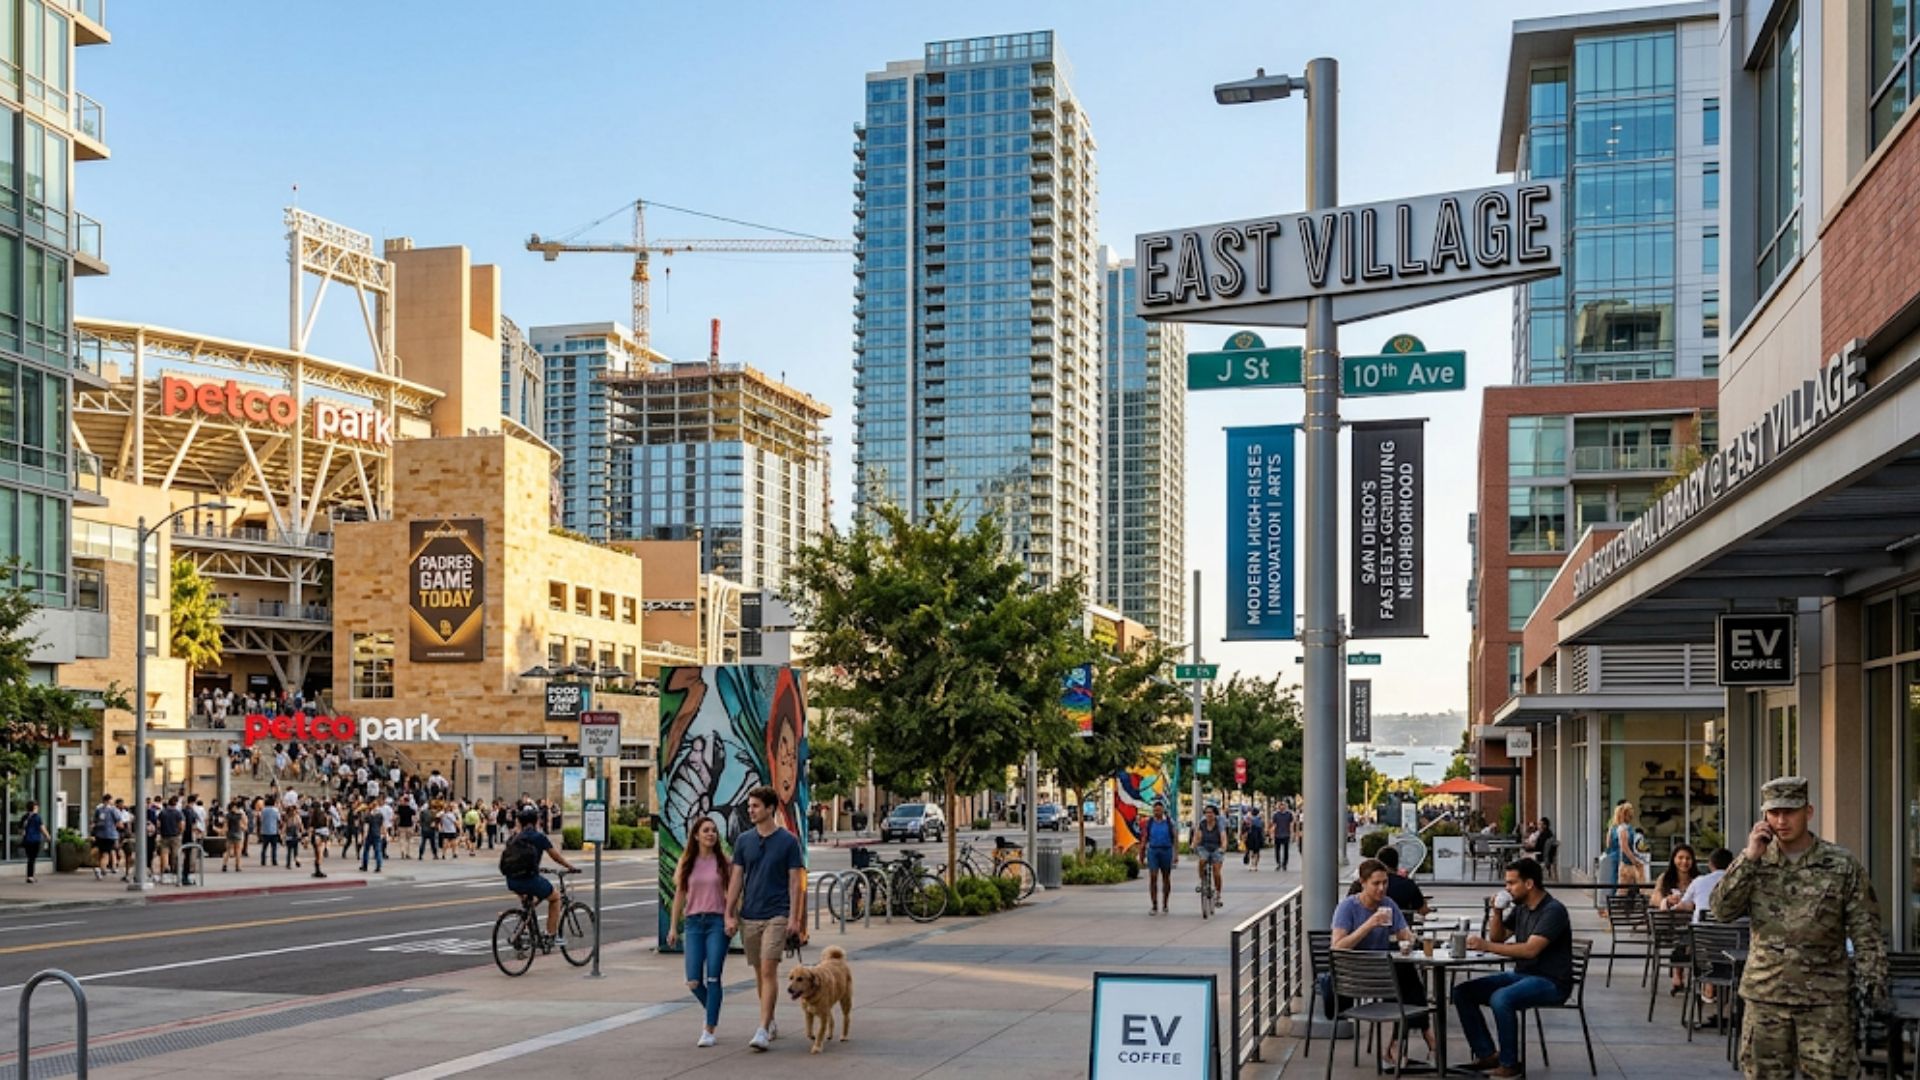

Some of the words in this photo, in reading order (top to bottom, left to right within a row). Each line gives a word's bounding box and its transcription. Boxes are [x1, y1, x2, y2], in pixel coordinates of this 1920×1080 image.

[1141, 220, 1281, 307] EAST
[1297, 184, 1552, 288] VILLAGE
[1217, 358, 1232, 382] J
[1243, 355, 1270, 380] St
[1353, 362, 1399, 388] 10th
[1408, 362, 1456, 386] Ave
[162, 376, 298, 426] petco
[313, 401, 394, 447] park
[1725, 412, 1768, 488] EAST
[1770, 338, 1864, 455] VILLAGE
[1268, 453, 1282, 497] ARTS
[1248, 443, 1262, 546] HIGH-RISES
[419, 554, 474, 571] PADRES
[420, 570, 473, 590] GAME
[1267, 512, 1282, 615] INNOVATION
[1361, 549, 1377, 585] SAN
[419, 589, 475, 608] TODAY
[1248, 551, 1262, 626] MODERN
[1731, 629, 1783, 657] EV
[360, 713, 441, 749] park
[1121, 1013, 1183, 1047] EV
[1117, 1050, 1182, 1066] COFFEE
